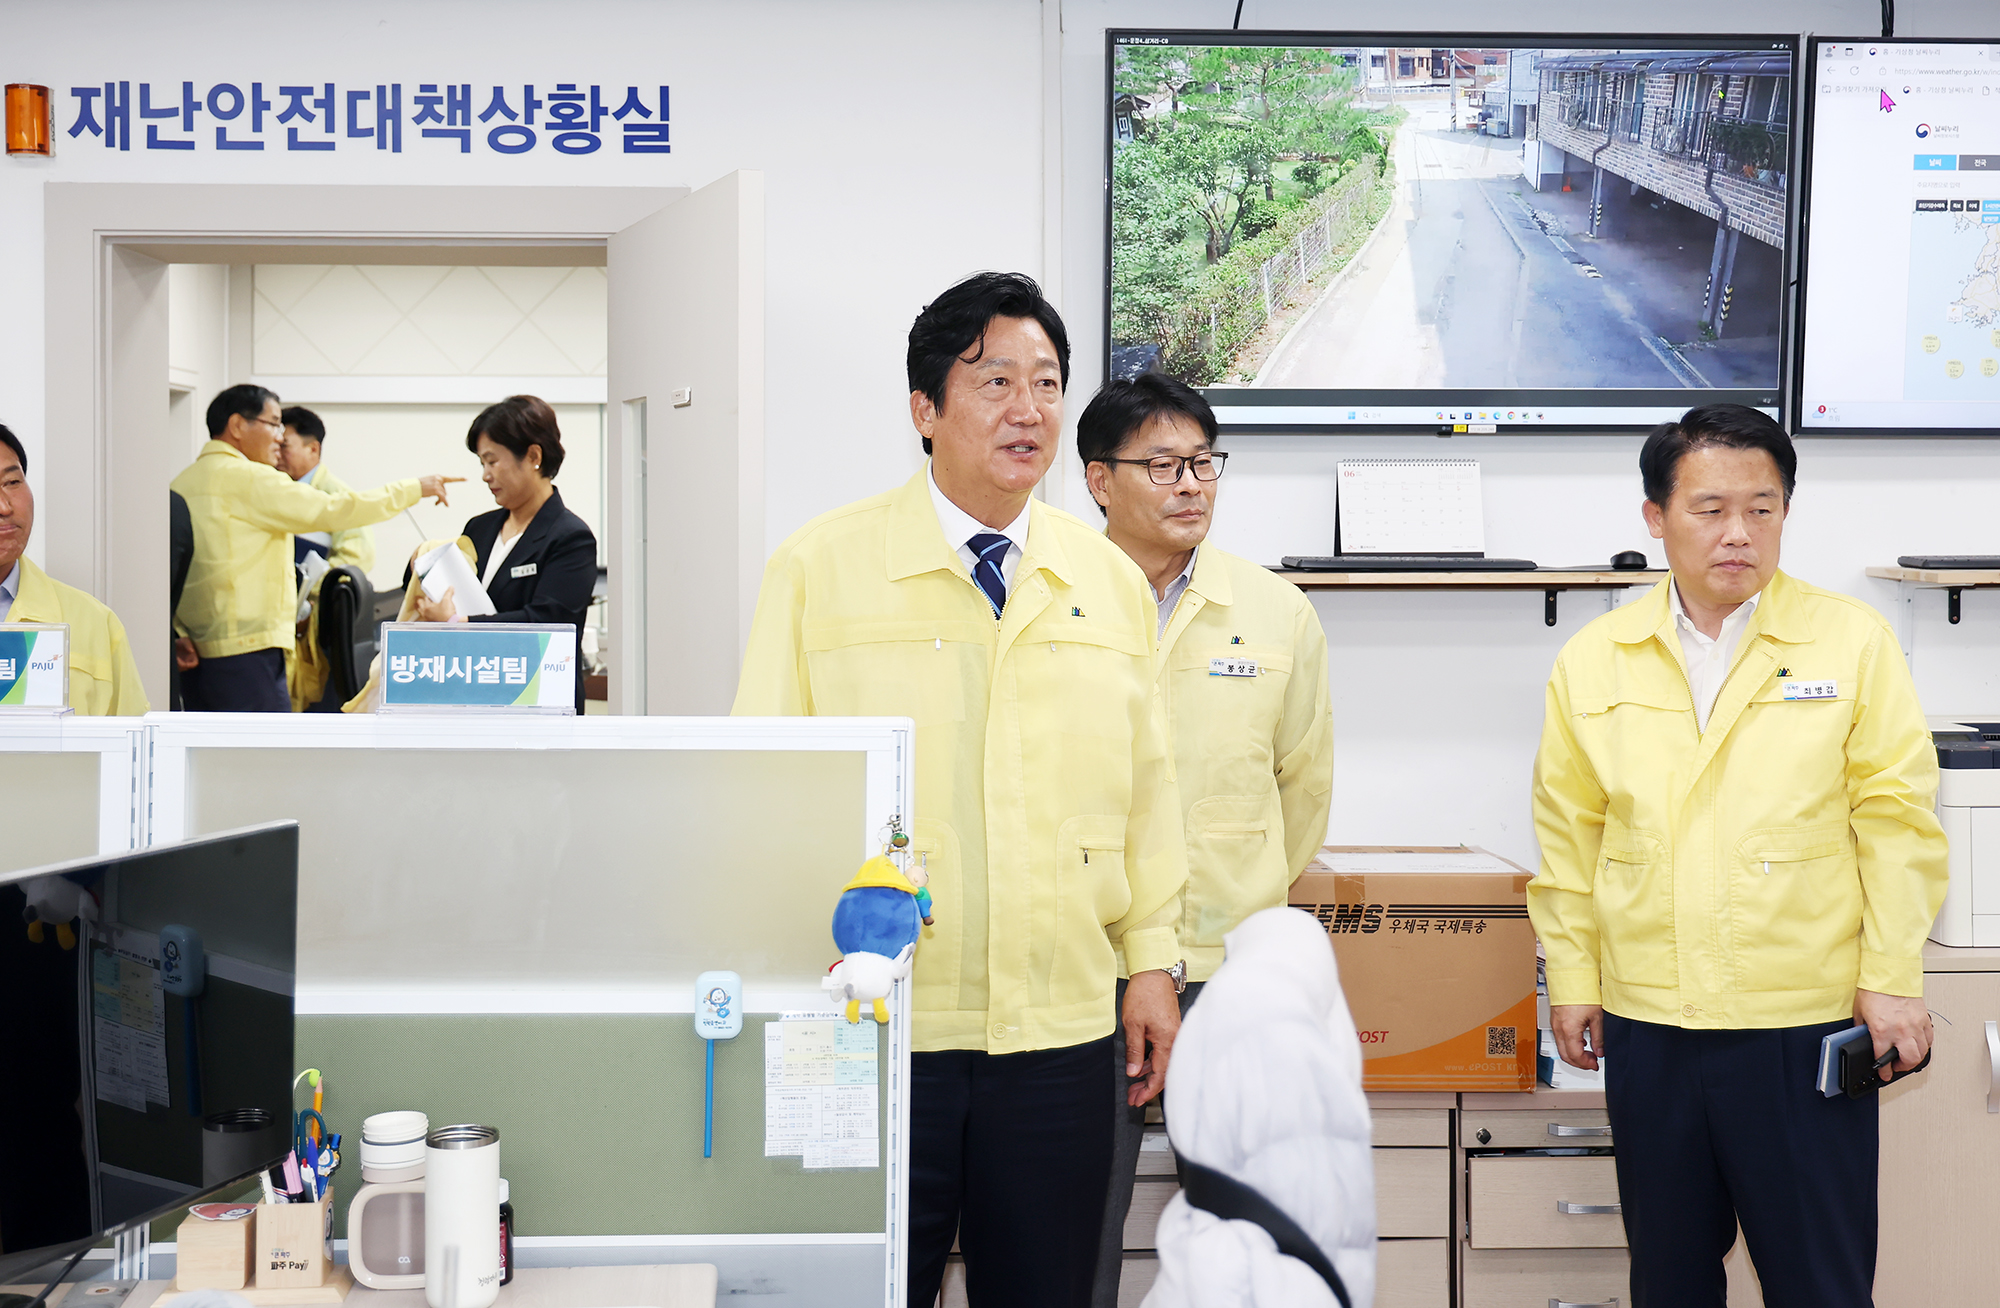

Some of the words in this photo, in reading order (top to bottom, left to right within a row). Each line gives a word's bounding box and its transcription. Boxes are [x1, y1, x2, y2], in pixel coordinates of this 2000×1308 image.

[1916, 48, 1941, 56] 날씨누리
[67, 81, 671, 155] 재난안전대책상황실
[1934, 125, 1959, 133] 날씨누리
[1928, 158, 1942, 167] 날씨
[1973, 158, 1987, 167] 전국
[1344, 470, 1355, 478] 06
[31, 662, 54, 671] PAJU
[390, 655, 528, 685] 방재시설팀
[544, 663, 566, 673] PAJU
[1317, 904, 1384, 934] EMS
[1388, 919, 1430, 934] 우체국
[1433, 919, 1488, 935] 국제특송
[270, 1261, 287, 1270] 파주
[289, 1260, 305, 1271] Pay
